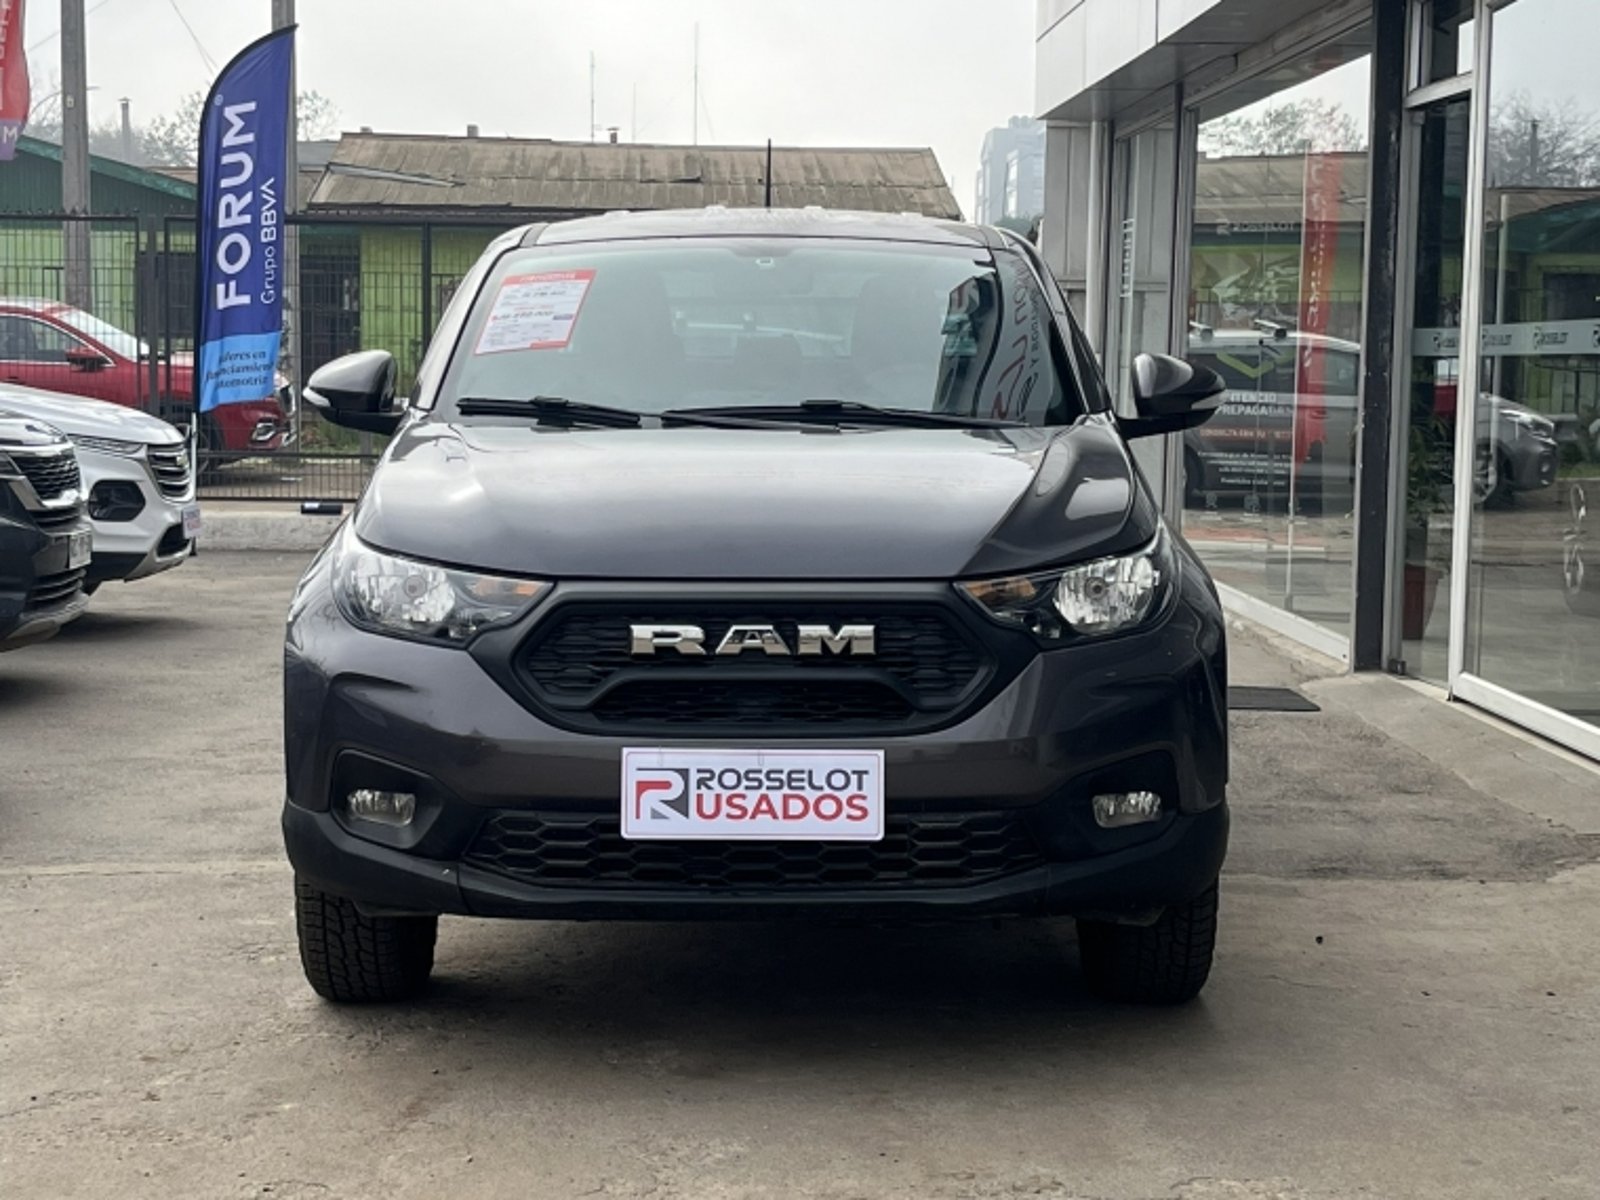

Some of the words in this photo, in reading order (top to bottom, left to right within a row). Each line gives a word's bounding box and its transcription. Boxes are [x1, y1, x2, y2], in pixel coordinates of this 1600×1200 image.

[216, 101, 257, 310] FORUM
[260, 177, 278, 243] BBVA
[260, 246, 278, 304] Grupo
[629, 624, 876, 656] RAM
[696, 768, 869, 792] ROSSELOT
[696, 793, 869, 821] USADOS
